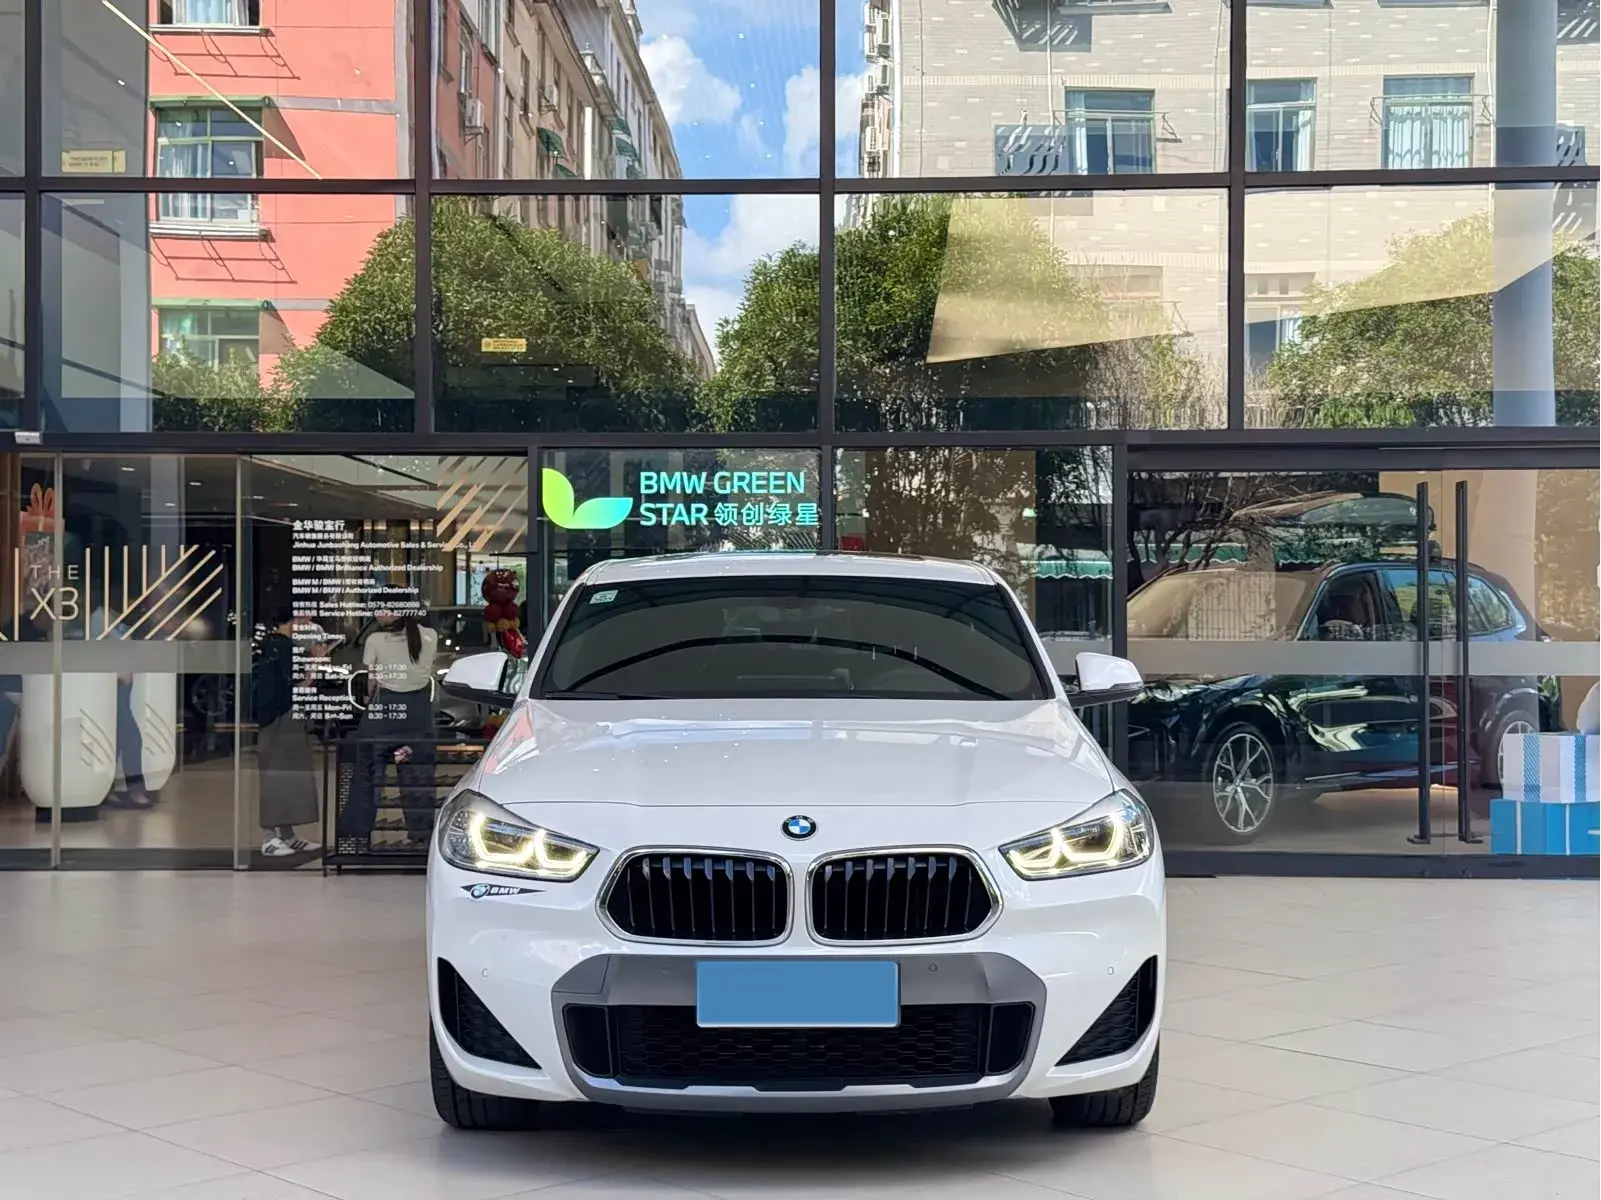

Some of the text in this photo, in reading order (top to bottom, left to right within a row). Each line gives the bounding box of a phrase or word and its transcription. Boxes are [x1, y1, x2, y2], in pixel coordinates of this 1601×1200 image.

[640, 471, 805, 495] BMW GREEN
[640, 502, 819, 526] STAR 领创绿星
[292, 519, 345, 531] 金华骏宝行
[292, 541, 316, 549] Jinhua
[400, 541, 419, 549] Sales
[420, 541, 426, 549] &
[292, 555, 311, 563] BMW
[30, 564, 79, 580] THE
[407, 564, 443, 572] Dealership
[292, 578, 311, 586] BMW
[323, 578, 341, 586] BMW
[383, 587, 419, 595] Dealership
[30, 586, 79, 621] X3
[319, 609, 345, 617] Service
[346, 609, 373, 617] Hotline:
[374, 609, 426, 617] 0579-82777740
[292, 633, 321, 641] Opening
[490, 886, 520, 895] BMW
